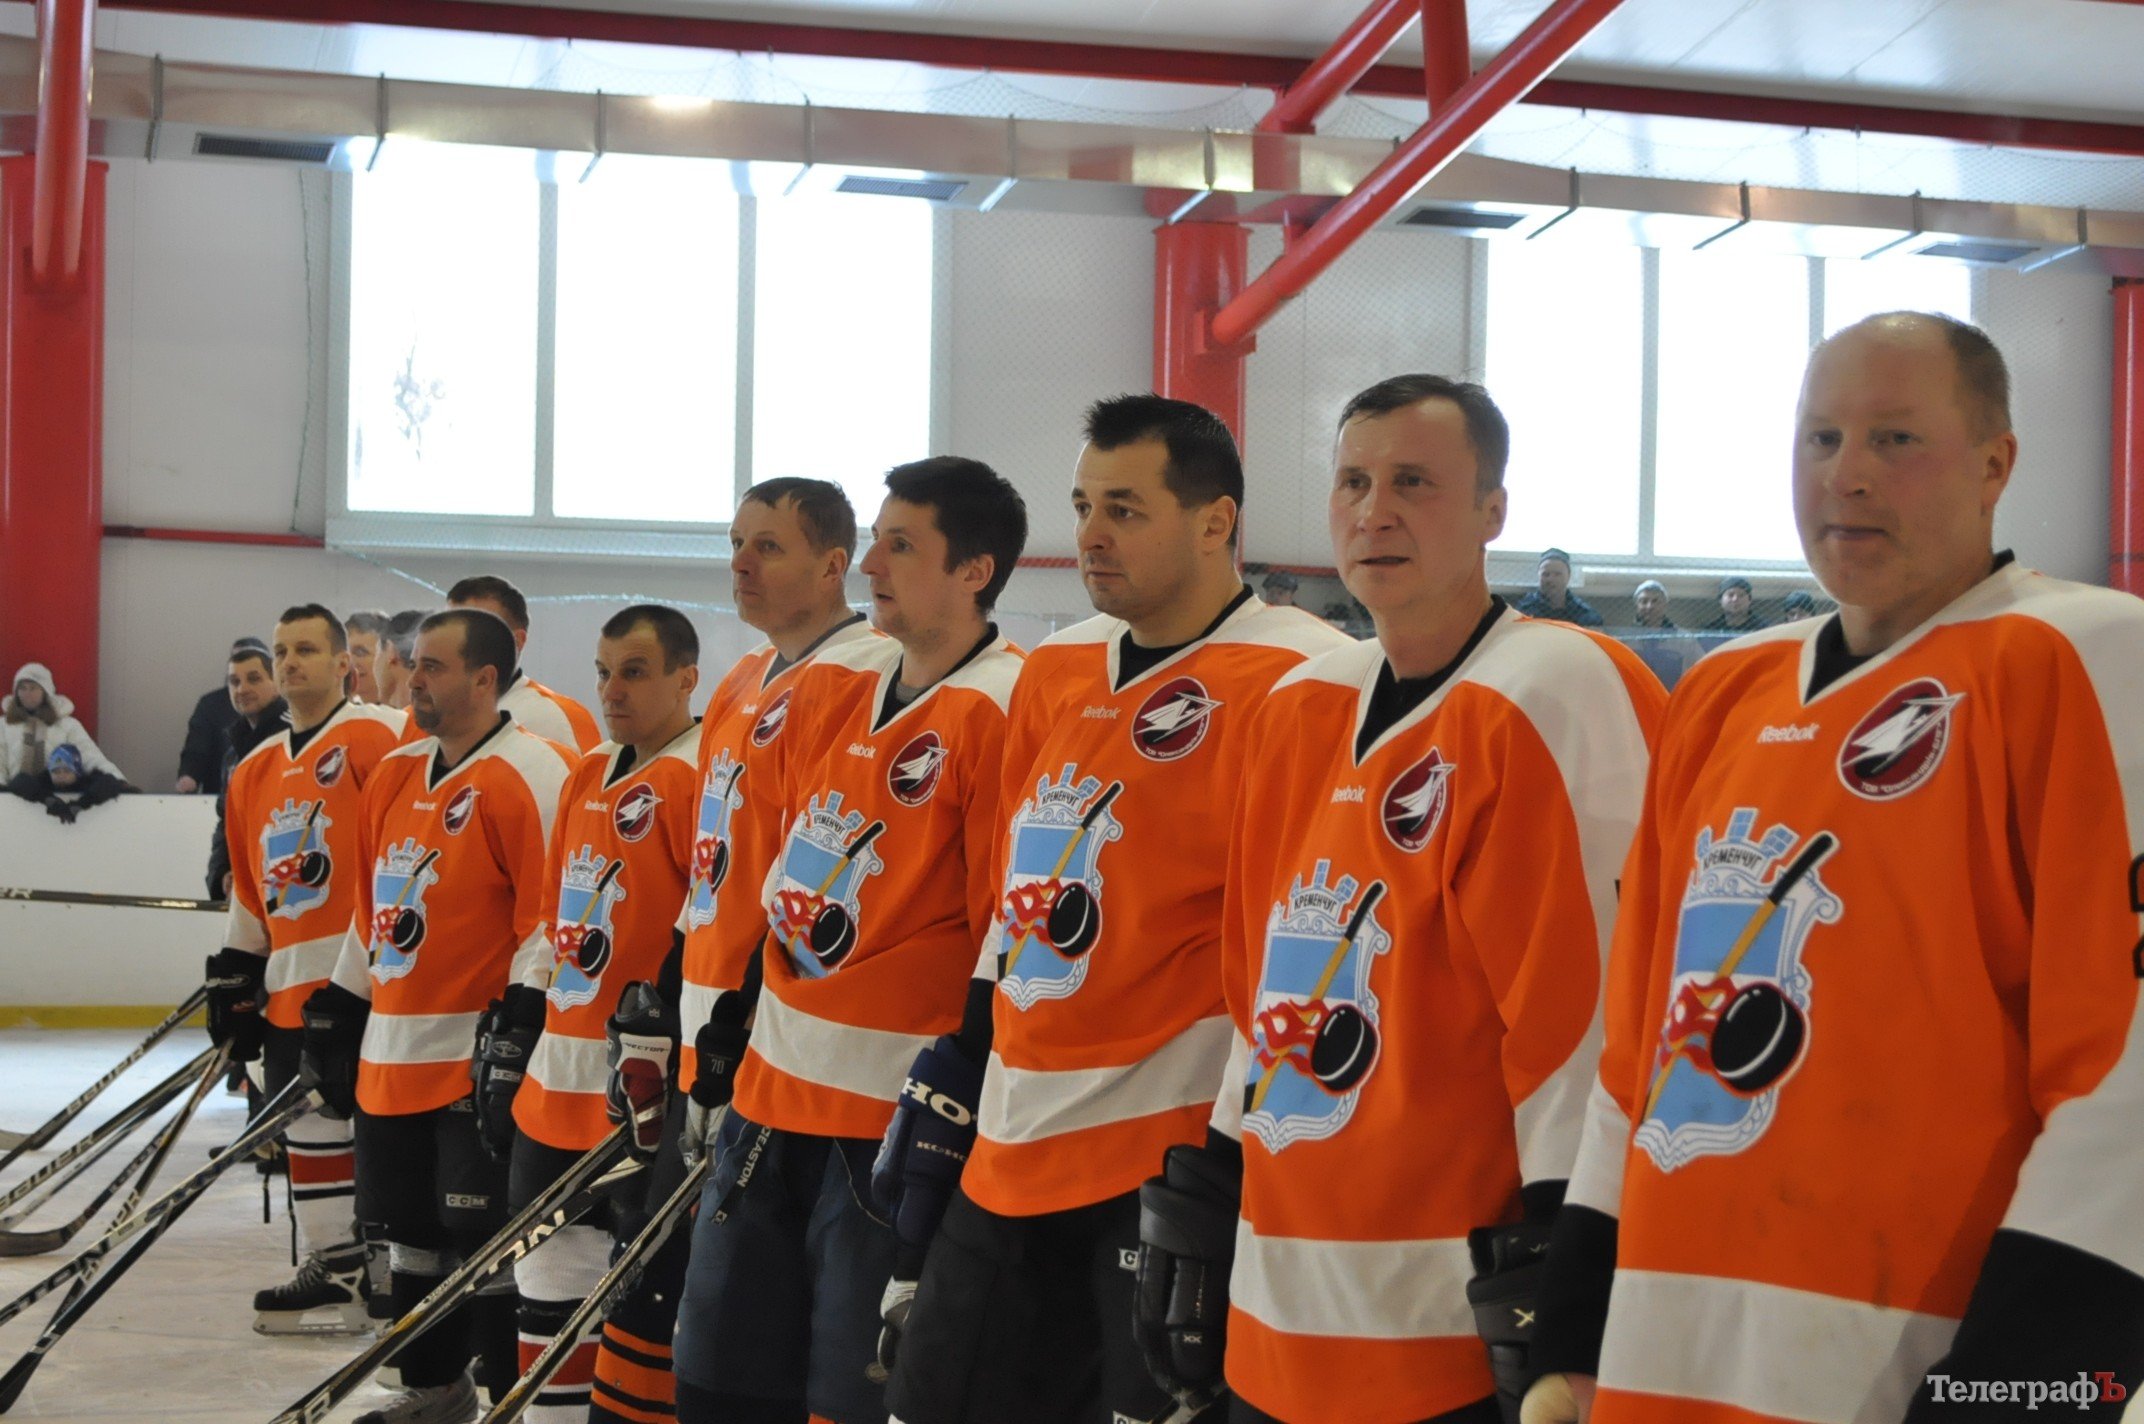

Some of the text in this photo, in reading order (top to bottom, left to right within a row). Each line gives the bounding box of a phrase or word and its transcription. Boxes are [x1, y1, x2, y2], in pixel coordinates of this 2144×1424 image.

[1757, 723, 1821, 743] Reebok
[711, 1058, 725, 1075] 70
[736, 1133, 769, 1189] EASTON
